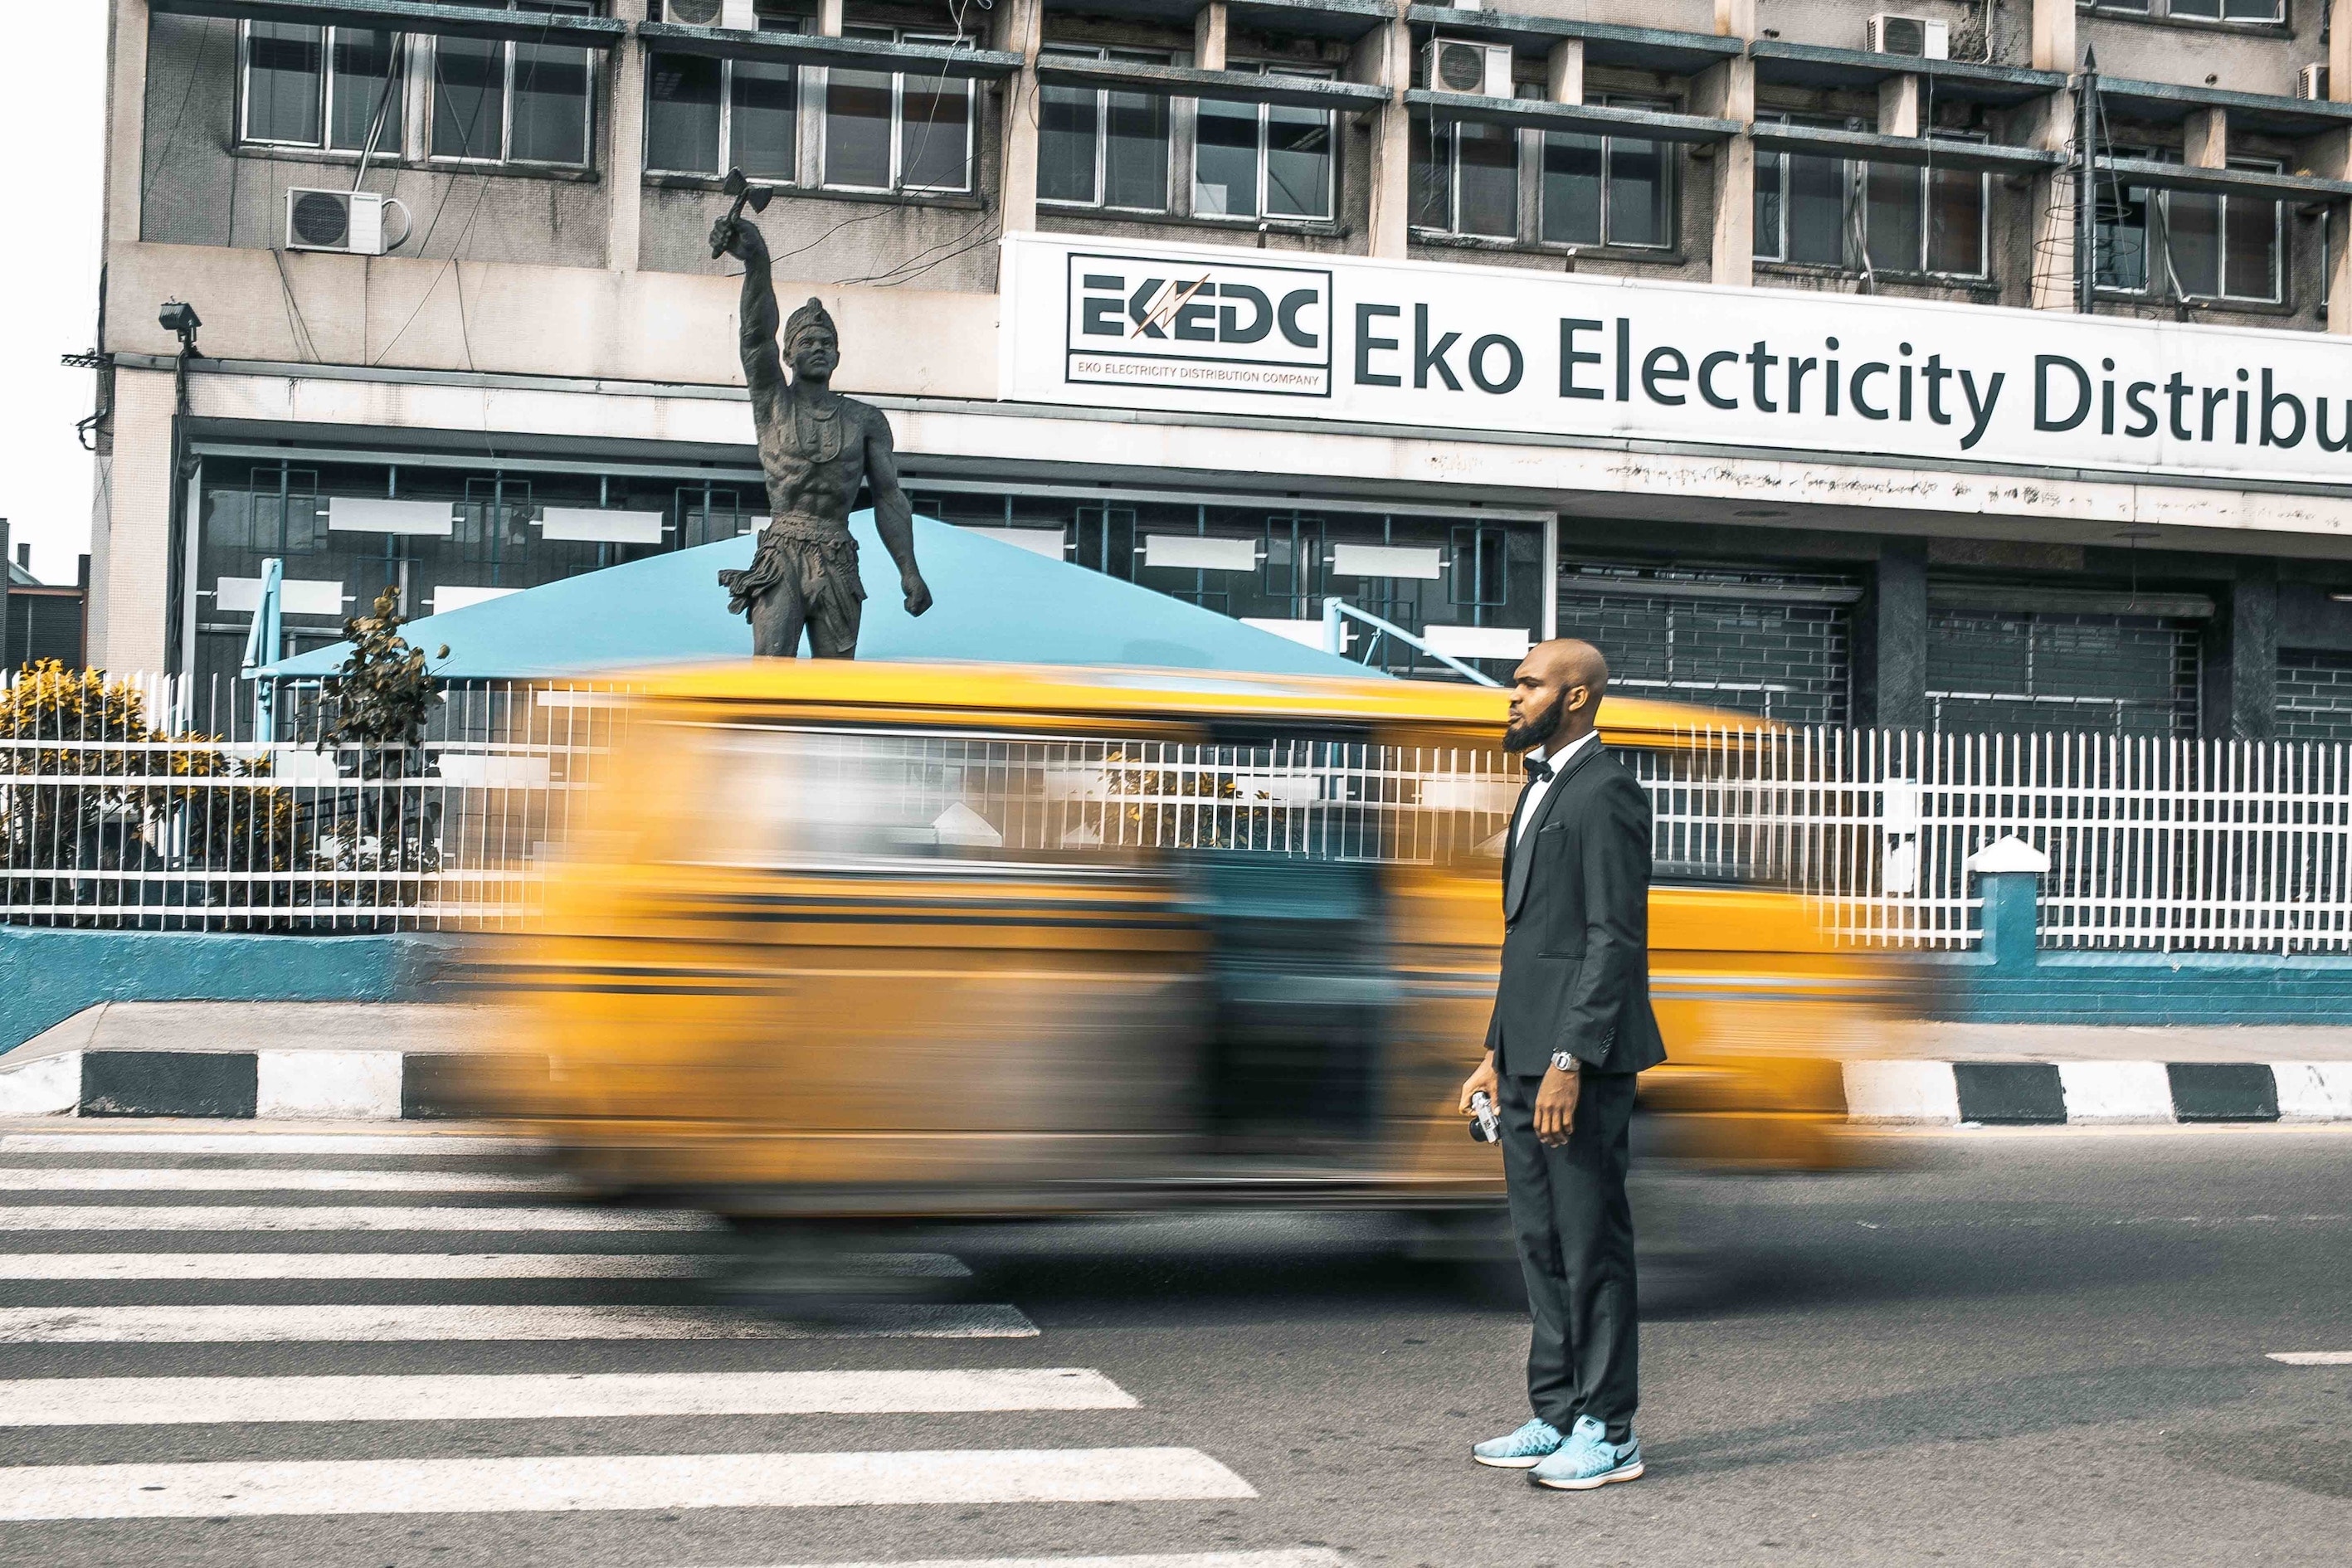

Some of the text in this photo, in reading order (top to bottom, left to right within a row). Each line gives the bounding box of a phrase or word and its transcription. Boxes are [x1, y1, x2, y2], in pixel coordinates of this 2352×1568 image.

[1082, 274, 1319, 349] EKEDC
[1077, 361, 1321, 387] EKO ELECTRICITY DISTRIBUTION COMPANY
[1354, 303, 2352, 453] Eko Electricity Distribu
